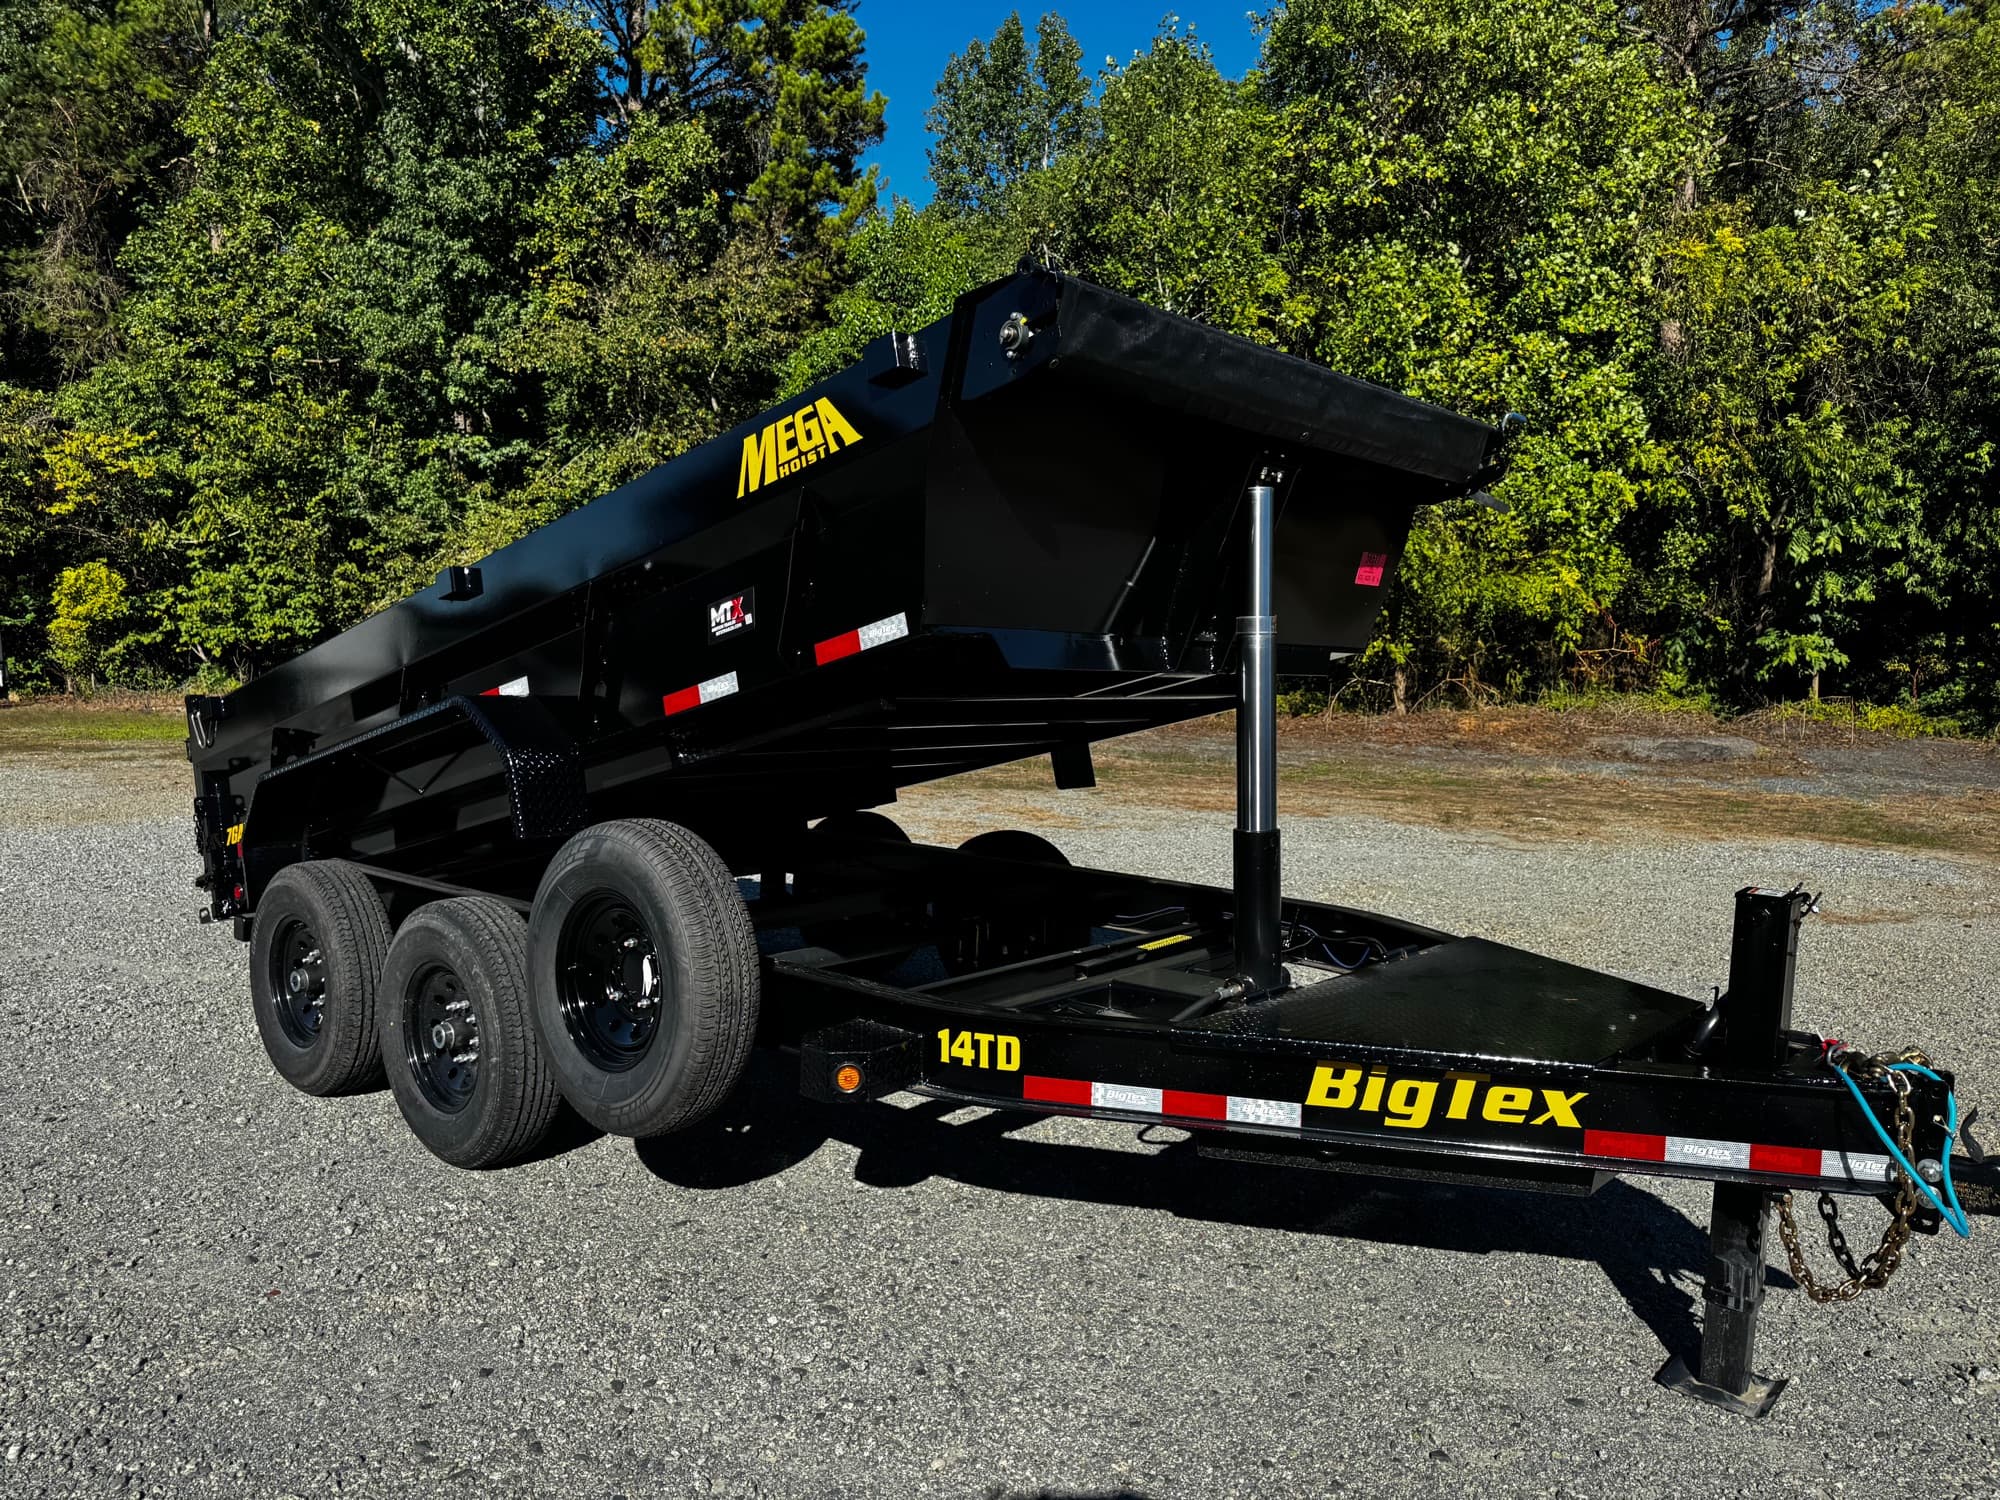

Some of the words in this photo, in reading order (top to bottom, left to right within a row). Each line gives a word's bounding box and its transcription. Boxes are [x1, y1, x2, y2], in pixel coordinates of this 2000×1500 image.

[737, 397, 863, 499] MEGA
[778, 445, 828, 479] HOIST
[711, 596, 744, 628] MTX
[937, 1028, 1021, 1071] 14TD
[1304, 1060, 1590, 1129] BigTex
